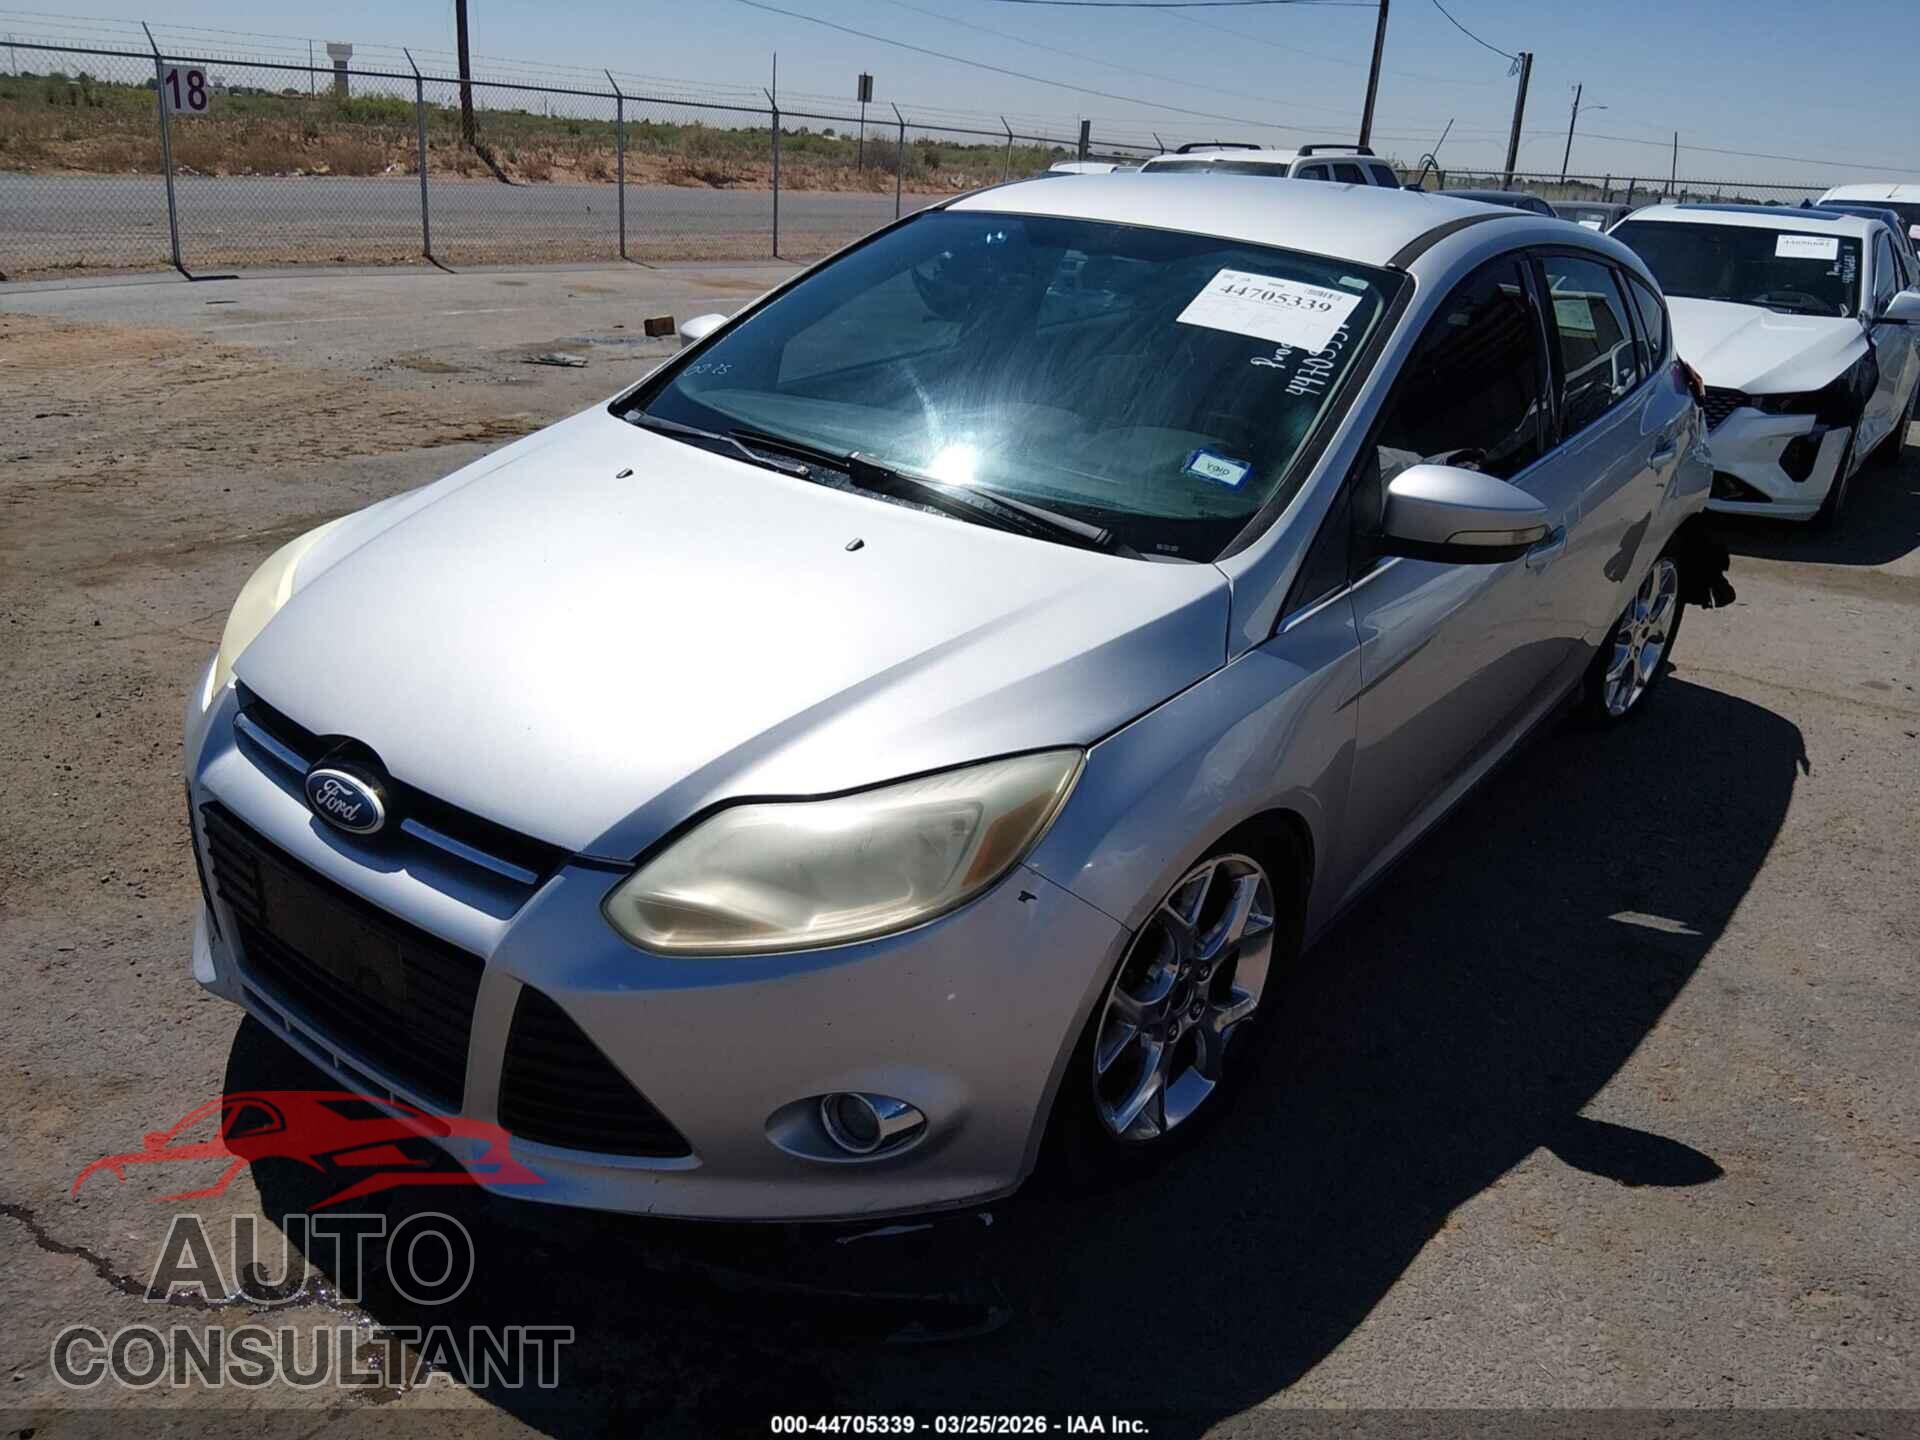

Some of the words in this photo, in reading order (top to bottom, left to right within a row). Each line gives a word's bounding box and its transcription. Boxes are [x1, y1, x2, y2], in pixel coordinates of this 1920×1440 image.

[165, 68, 207, 111] 18
[1219, 283, 1333, 313] 44705339
[316, 779, 362, 821] Ford
